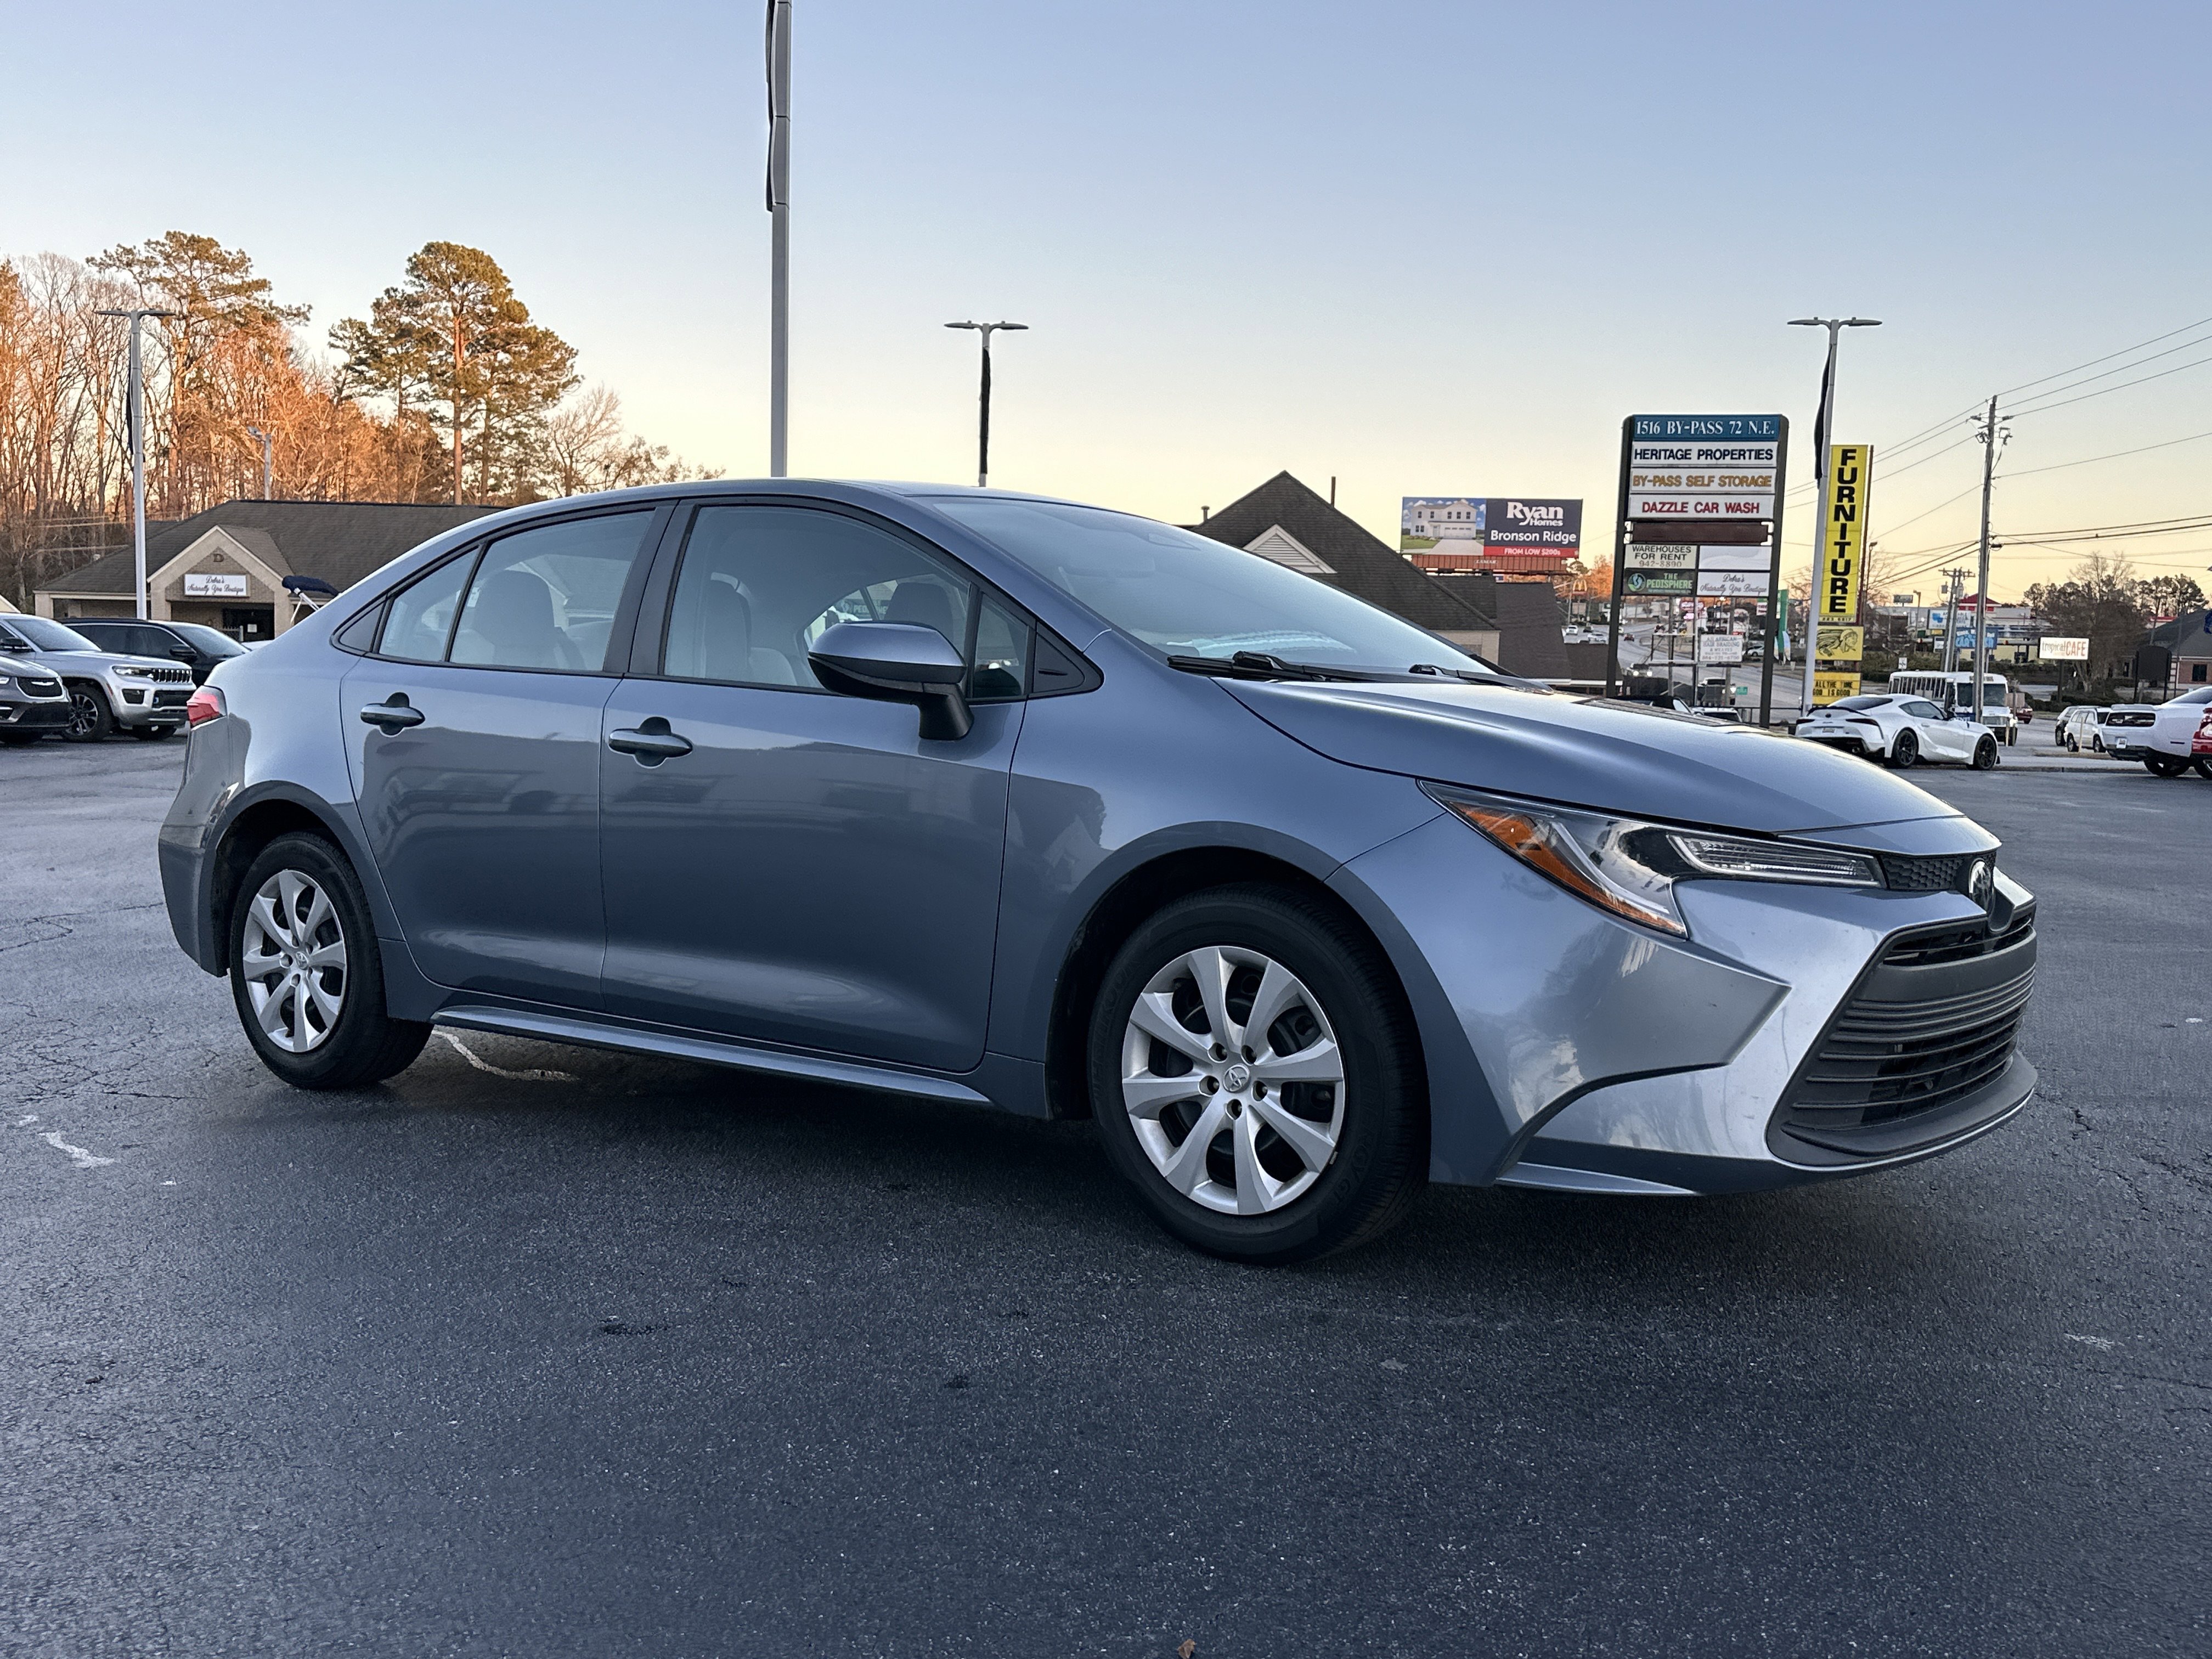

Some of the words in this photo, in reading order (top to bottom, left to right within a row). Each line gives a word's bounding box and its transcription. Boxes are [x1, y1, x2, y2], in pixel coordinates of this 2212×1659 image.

[1635, 421, 1661, 435] 1516
[1667, 421, 1723, 435] BY-PASS
[1729, 421, 1742, 434] 72
[1748, 420, 1775, 435] N.E.
[1634, 449, 1692, 460] HERITAGE
[1697, 449, 1773, 460] PROPERTIES
[1633, 476, 1681, 487] BY-PASS
[1686, 476, 1715, 487] SELF
[1718, 476, 1772, 487] STORAGE
[1506, 501, 1564, 526] Ryan
[1641, 501, 1689, 513] DAZZLE
[1694, 502, 1719, 514] CAR
[1724, 502, 1760, 514] WASH
[1491, 530, 1539, 541] Bronson
[1543, 531, 1577, 544] Ridge
[1829, 448, 1858, 613] FURNITURE
[1632, 545, 1691, 553] WAREHOUSES
[1646, 579, 1693, 589] PEDISPHERE
[2042, 641, 2066, 653] tropical
[2066, 640, 2086, 656] CAFE
